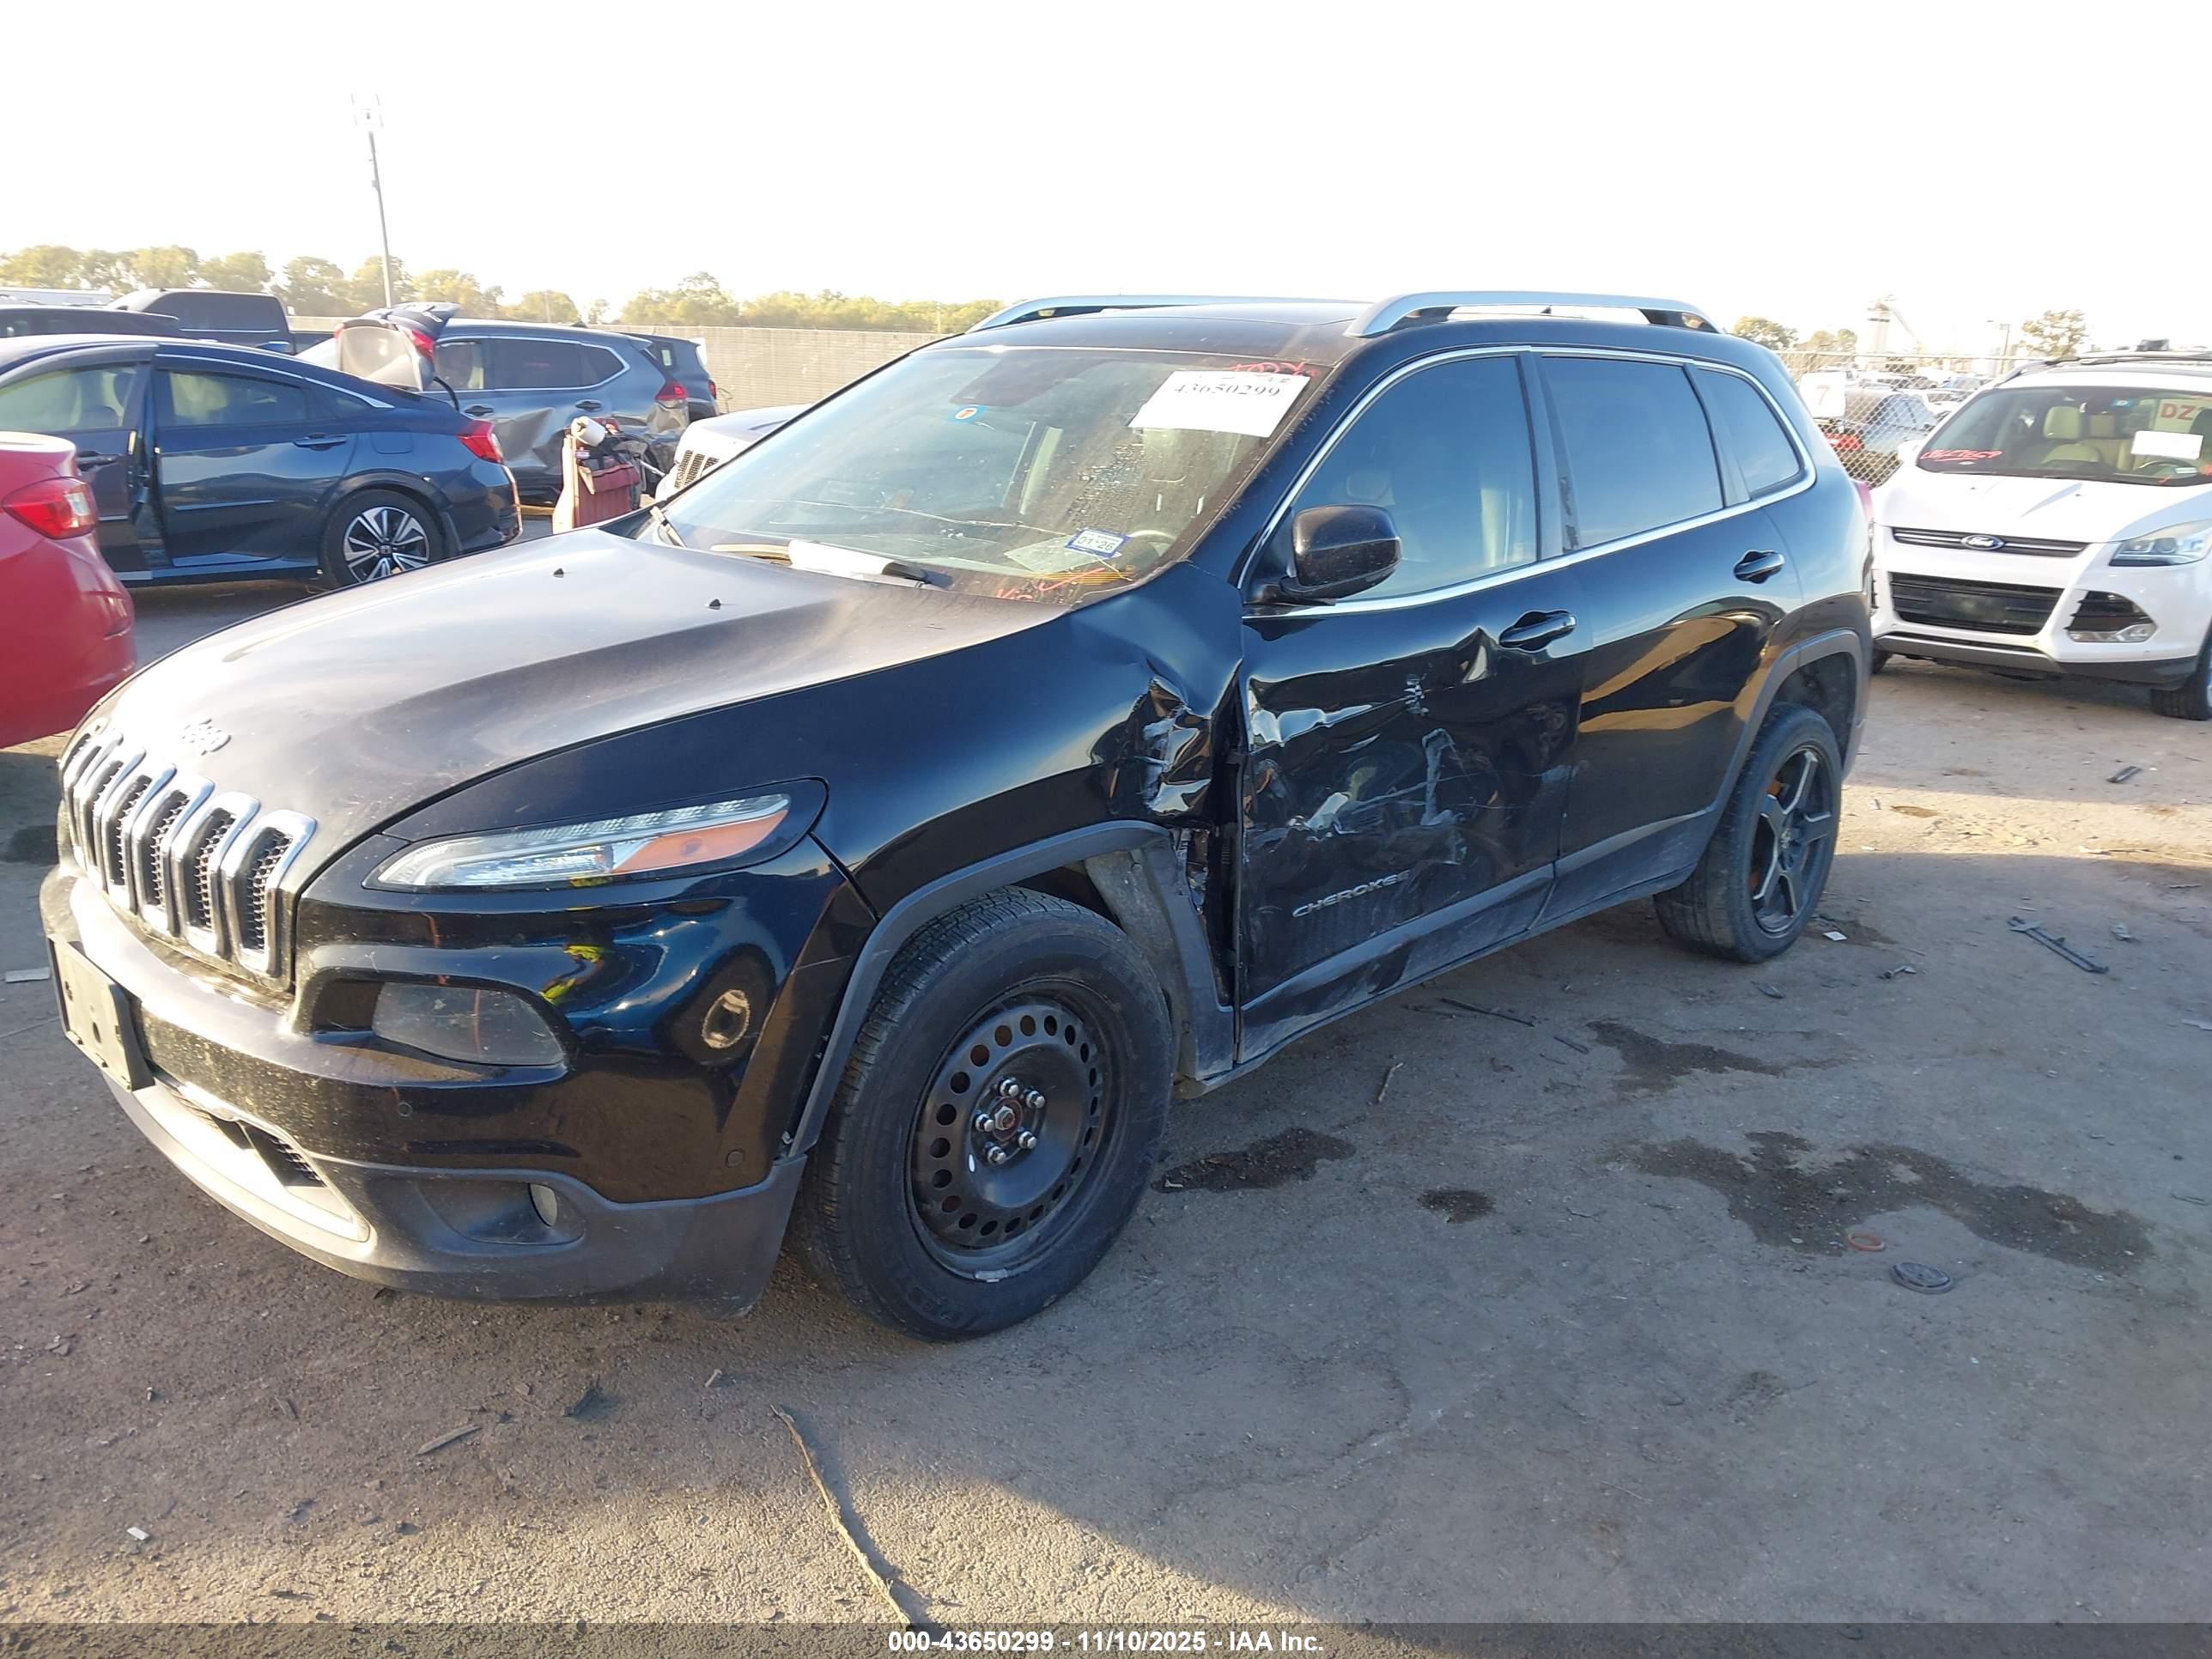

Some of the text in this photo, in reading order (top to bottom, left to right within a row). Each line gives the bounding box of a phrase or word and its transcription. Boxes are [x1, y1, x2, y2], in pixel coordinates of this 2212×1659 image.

[1173, 383, 1282, 398] 43650299
[2160, 402, 2205, 421] DZ
[1291, 869, 1412, 918] CHEROKEE
